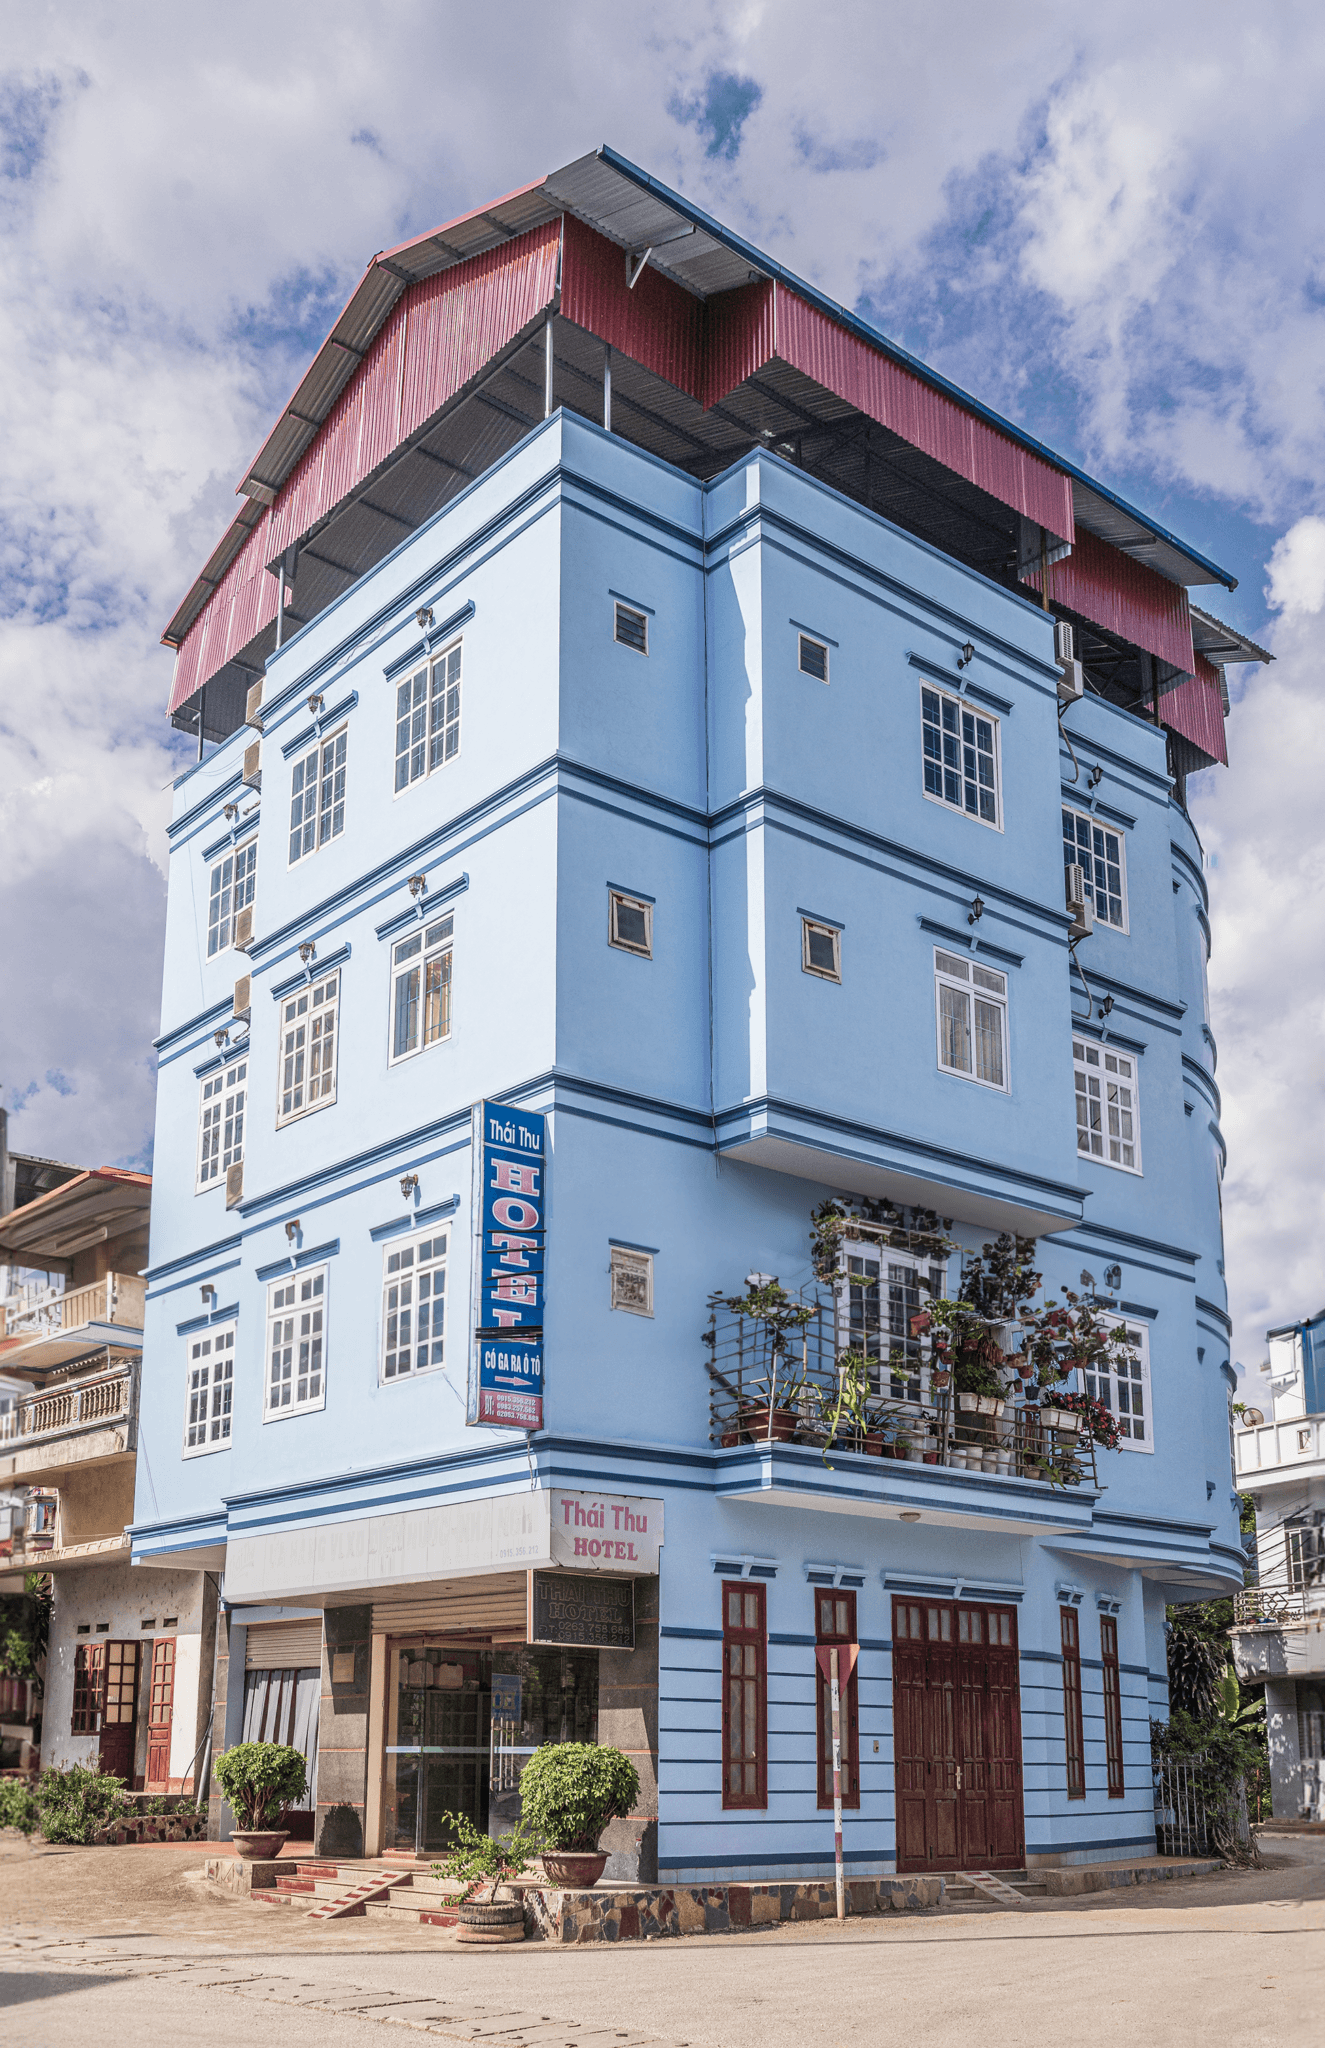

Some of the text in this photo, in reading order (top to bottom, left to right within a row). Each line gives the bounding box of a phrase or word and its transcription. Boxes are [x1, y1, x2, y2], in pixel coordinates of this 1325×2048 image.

[489, 1118, 541, 1150] Thái Thu
[490, 1158, 540, 1345] HOTEL
[485, 1348, 541, 1376] CÓ GA RA Ô TÔ
[561, 1499, 605, 1528] Thái
[611, 1504, 648, 1533] Thu
[573, 1537, 638, 1561] HOTEL
[590, 1585, 631, 1607] THU
[548, 1601, 623, 1624] HOTEL
